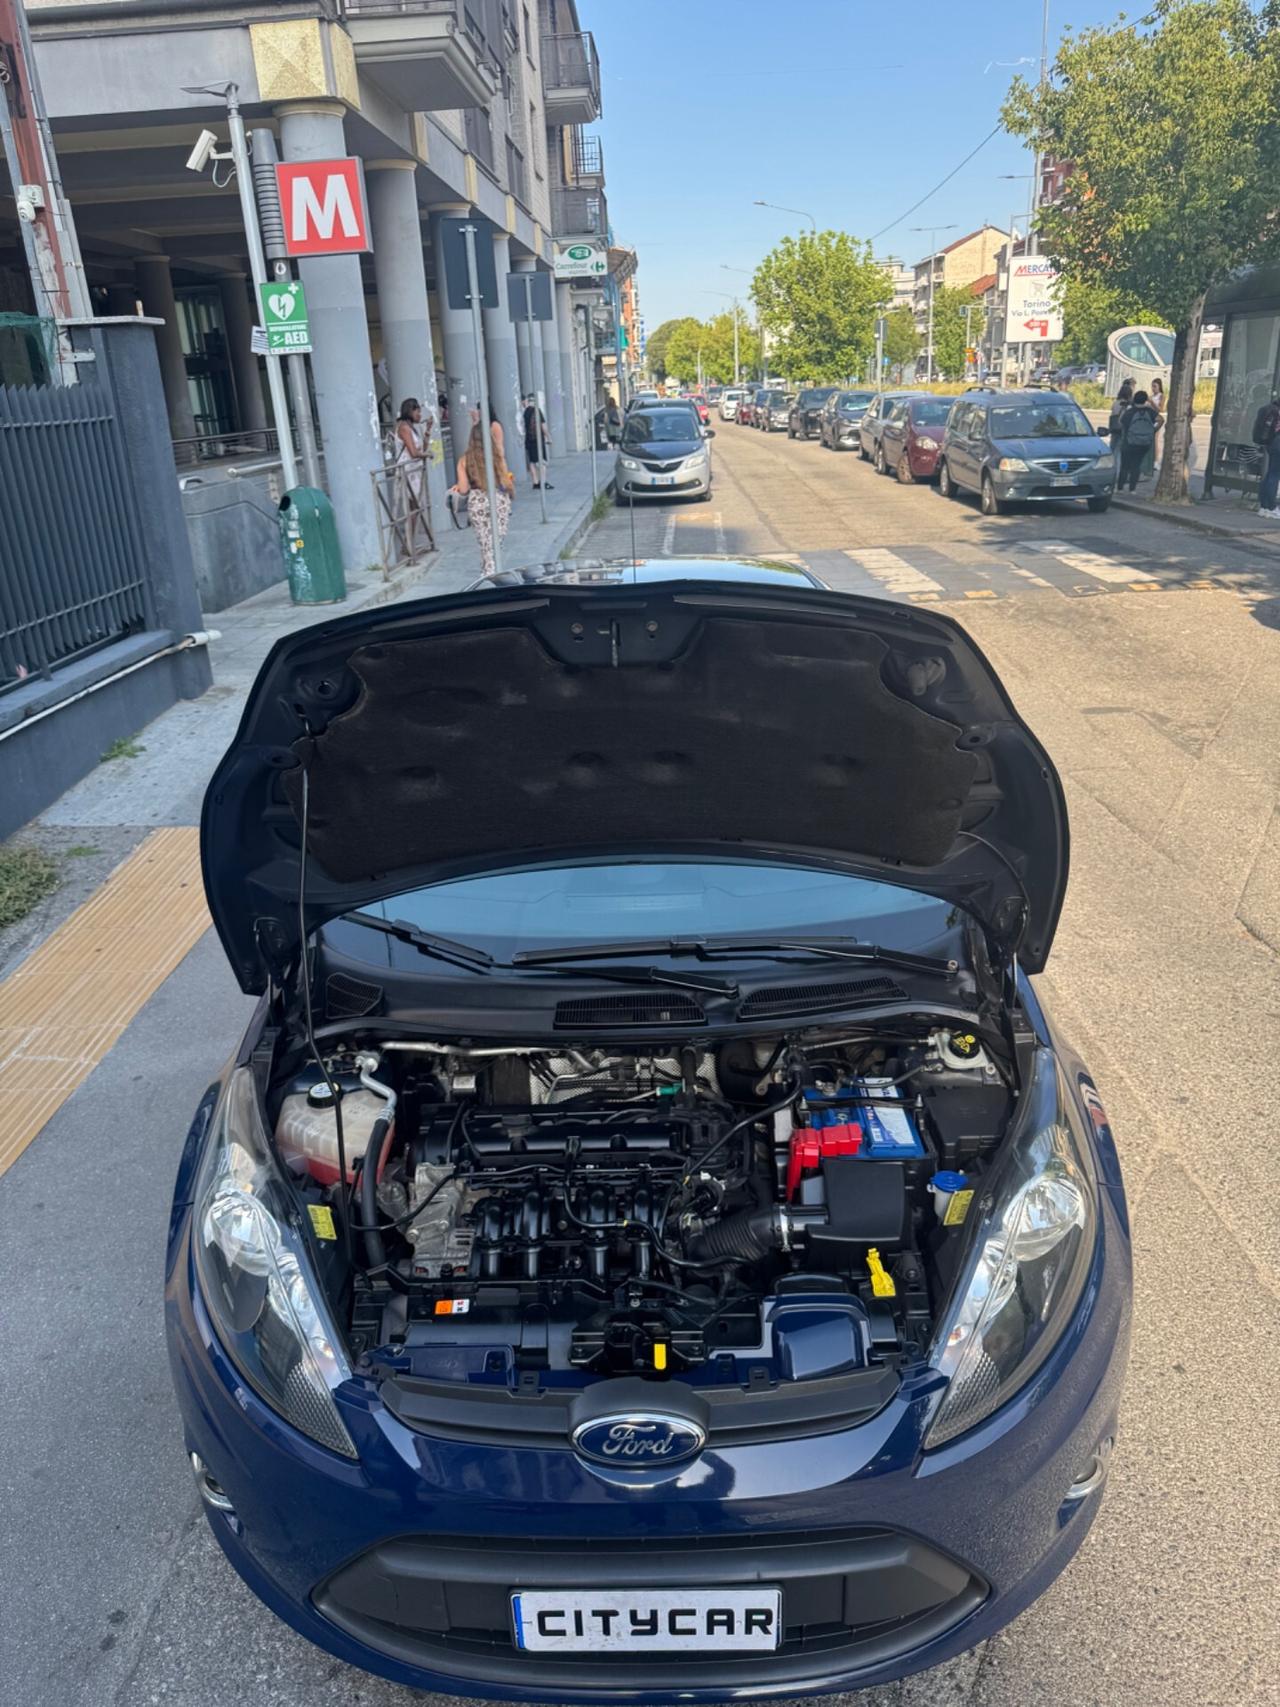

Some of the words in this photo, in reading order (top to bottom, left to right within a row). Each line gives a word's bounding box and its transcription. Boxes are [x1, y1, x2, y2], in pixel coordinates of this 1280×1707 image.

[291, 174, 360, 241] M
[1014, 263, 1058, 277] MERCAT
[1023, 299, 1051, 308] Torino
[284, 331, 308, 346] AED
[602, 1424, 674, 1455] Ford
[537, 1608, 774, 1637] CITYCAR
